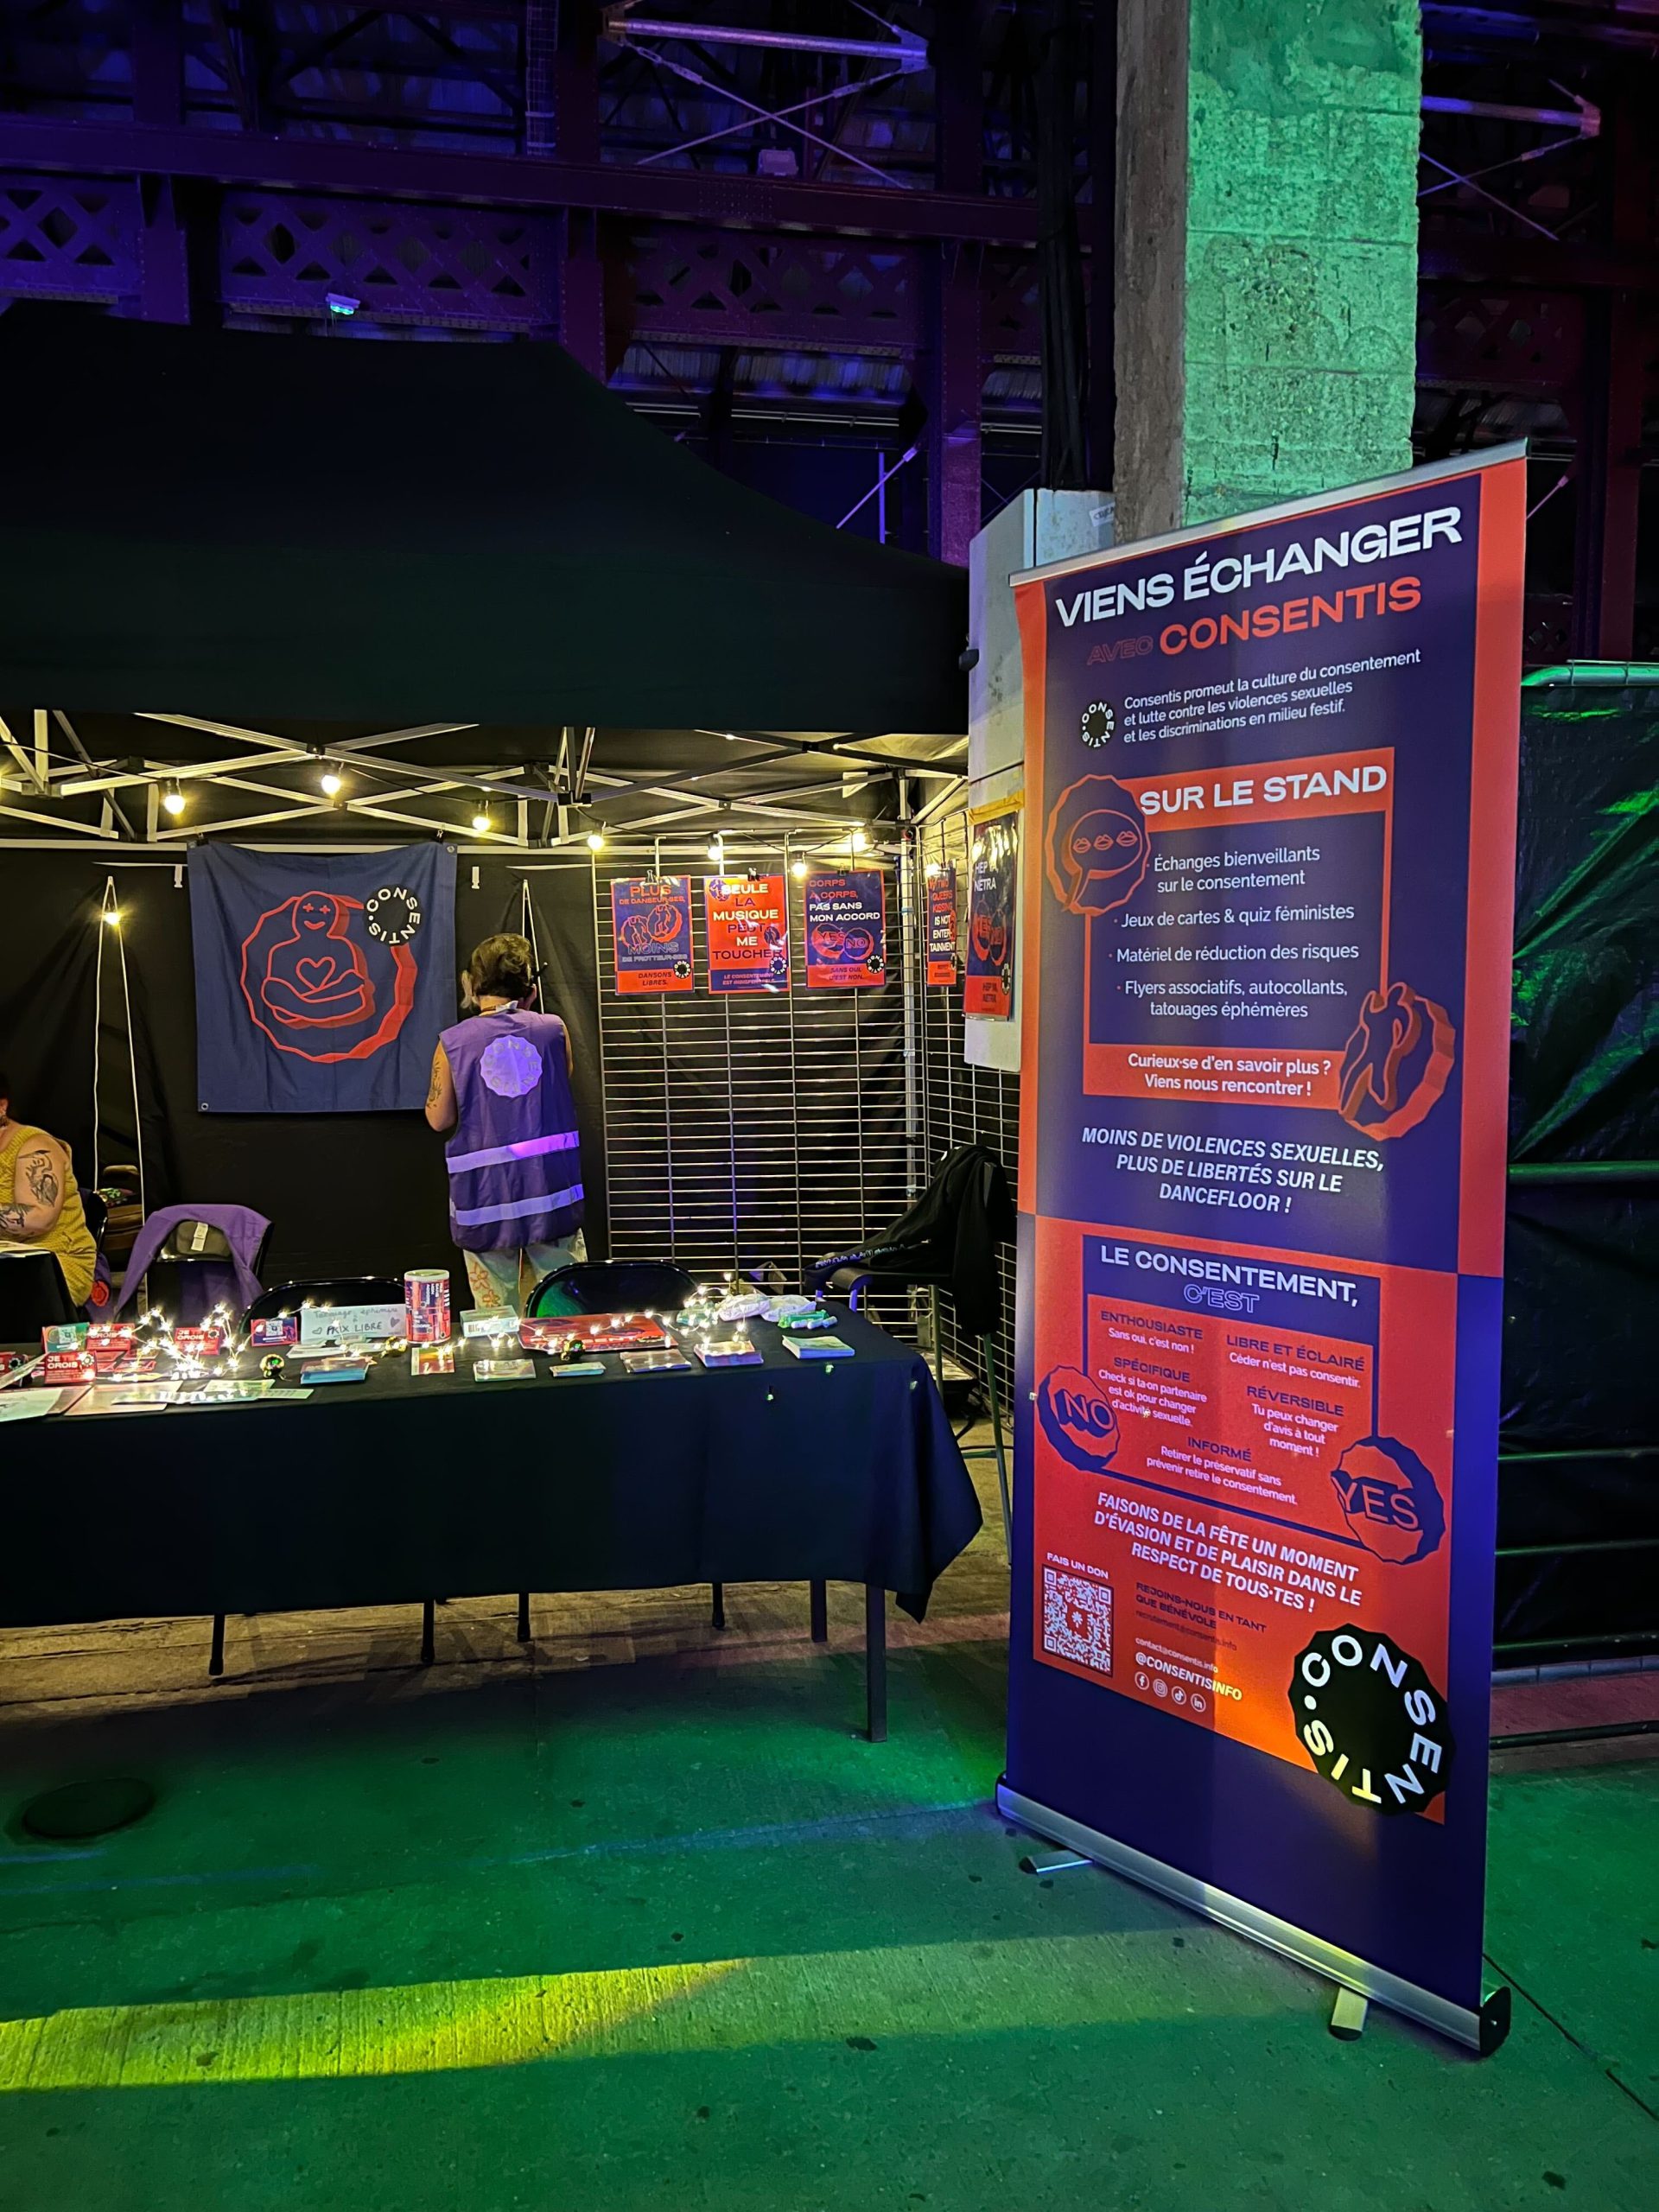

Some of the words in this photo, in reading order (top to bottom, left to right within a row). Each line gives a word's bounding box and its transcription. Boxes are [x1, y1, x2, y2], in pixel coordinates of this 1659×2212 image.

[1056, 573, 1174, 626] VIENS
[1184, 507, 1462, 601] ÉCHANGER
[1086, 636, 1154, 665] AVEC
[1159, 576, 1421, 657] CONSENTIS
[1124, 687, 1181, 709] Consentis
[1184, 680, 1234, 704] promeut
[1252, 671, 1296, 690] culture
[1300, 666, 1317, 683] du
[1319, 649, 1421, 681] consentement
[1138, 706, 1166, 724] lutte
[1169, 702, 1204, 719] contre
[1207, 697, 1225, 715] les
[1228, 690, 1287, 712] violences
[1290, 681, 1353, 705] sexuelles
[1139, 724, 1155, 741] les
[1158, 714, 1245, 738] discriminations
[1268, 703, 1306, 724] milieu
[1310, 699, 1345, 720] festif.
[1141, 786, 1204, 815] SUR
[1213, 781, 1254, 809] LE
[1263, 766, 1387, 802] STAND
[975, 862, 988, 874] HEP
[1154, 852, 1220, 874] Échanges
[1224, 846, 1320, 867] bienveillants
[630, 884, 671, 898] PLUS
[721, 883, 768, 894] SEULE
[809, 879, 846, 887] CORPS
[974, 878, 997, 892] NETRA
[1157, 880, 1181, 893] sur
[1197, 869, 1306, 891] consentement
[735, 898, 755, 907] LA
[809, 903, 830, 912] PAS
[832, 902, 862, 911] SANS
[713, 909, 779, 921] MUSIQUE
[810, 914, 834, 923] MON
[836, 912, 880, 921] ACCORD
[934, 916, 941, 926] IS
[941, 914, 951, 926] NOT
[1121, 913, 1154, 928] Jeux
[1157, 912, 1174, 926] de
[1177, 910, 1221, 925] cartes
[1238, 907, 1271, 926] quiz
[1274, 904, 1354, 922] féministes
[628, 941, 679, 956] MOINS
[736, 936, 759, 946] ME
[929, 941, 956, 952] TAINMENT
[712, 949, 782, 960] TOUCHER
[1117, 948, 1172, 963] Matériel
[1174, 948, 1192, 962] de
[1196, 945, 1266, 961] réduction
[1270, 944, 1298, 960] des
[1302, 944, 1359, 964] risques
[1125, 979, 1166, 997] Flyers
[1168, 979, 1245, 997] associatifs,
[1249, 980, 1348, 997] autocollants,
[1150, 1001, 1217, 1019] tatouages
[1221, 1000, 1308, 1020] éphémères
[1236, 1058, 1283, 1073] savoir
[1286, 1058, 1319, 1077] plus
[1145, 1074, 1181, 1090] Viens
[1184, 1078, 1218, 1091] nous
[1221, 1080, 1303, 1096] rencontrer
[1082, 1127, 1137, 1147] MOINS
[1141, 1131, 1165, 1149] DE
[1166, 1134, 1267, 1159] VIOLENCES
[1269, 1142, 1384, 1172] SEXUELLES,
[1116, 1154, 1157, 1173] PLUS
[1161, 1158, 1185, 1176] DE
[1187, 1160, 1273, 1185] LIBERTÉS
[1276, 1169, 1315, 1190] SUR
[1319, 1173, 1343, 1192] LE
[1159, 1183, 1281, 1211] DANCEFLOOR
[1101, 1245, 1129, 1266] LE
[1135, 1249, 1360, 1307] CONSENTEMENT,
[1184, 1284, 1260, 1314] C'EST
[354, 1322, 383, 1332] LIBRE
[1101, 1311, 1203, 1339] ENTHOUSIASTE
[1109, 1328, 1130, 1341] Sans
[1227, 1334, 1269, 1352] LIBRE
[1274, 1344, 1293, 1356] ET
[1297, 1345, 1364, 1371] ÉCLAIRÉ
[1114, 1357, 1191, 1382] SPÉCIFIQUE
[1230, 1351, 1261, 1367] Céder
[1289, 1364, 1308, 1376] pas
[1310, 1370, 1361, 1389] consentir.
[1098, 1369, 1127, 1383] Check
[1160, 1384, 1208, 1403] partenaire
[1062, 1390, 1114, 1433] NO
[1159, 1397, 1197, 1414] changer
[1247, 1385, 1344, 1416] RÉVERSIBLE
[1153, 1409, 1193, 1427] sexuelle.
[1267, 1409, 1293, 1421] peux
[1295, 1414, 1339, 1433] changer
[1269, 1438, 1313, 1456] moment
[1304, 1429, 1326, 1444] tout
[1187, 1436, 1252, 1462] INFORMÉ
[1147, 1457, 1184, 1474] prévenir
[1161, 1446, 1192, 1463] Retirer
[1205, 1457, 1257, 1479] préservatif
[1258, 1472, 1281, 1486] sans
[1335, 1479, 1420, 1530] YES
[1097, 1492, 1160, 1522] FAISONS
[1162, 1511, 1184, 1530] DE
[1185, 1518, 1205, 1537] LA
[1210, 1524, 1249, 1550] FÊTE
[1252, 1537, 1277, 1558] UN
[1280, 1546, 1359, 1582] MOMENT
[1046, 1552, 1069, 1567] FAIS
[1071, 1560, 1085, 1572] UN
[1087, 1565, 1109, 1580] DON
[1094, 1510, 1172, 1547] D'ÉVASION
[1174, 1535, 1194, 1553] ET
[1196, 1542, 1218, 1561] DE
[1221, 1550, 1285, 1583] PLAISIR
[1287, 1569, 1336, 1598] DANS
[1339, 1586, 1363, 1606] LE
[1131, 1541, 1198, 1574] RESPECT
[1200, 1564, 1223, 1584] DE
[1136, 1582, 1217, 1616] REJOINS-NOUS
[1218, 1610, 1235, 1623] EN
[1236, 1616, 1267, 1632] TANT
[1136, 1594, 1157, 1608] QUE
[1160, 1602, 1217, 1629] BÉNÉVOLE
[1135, 1651, 1243, 1701] @CONSENTISINFO
